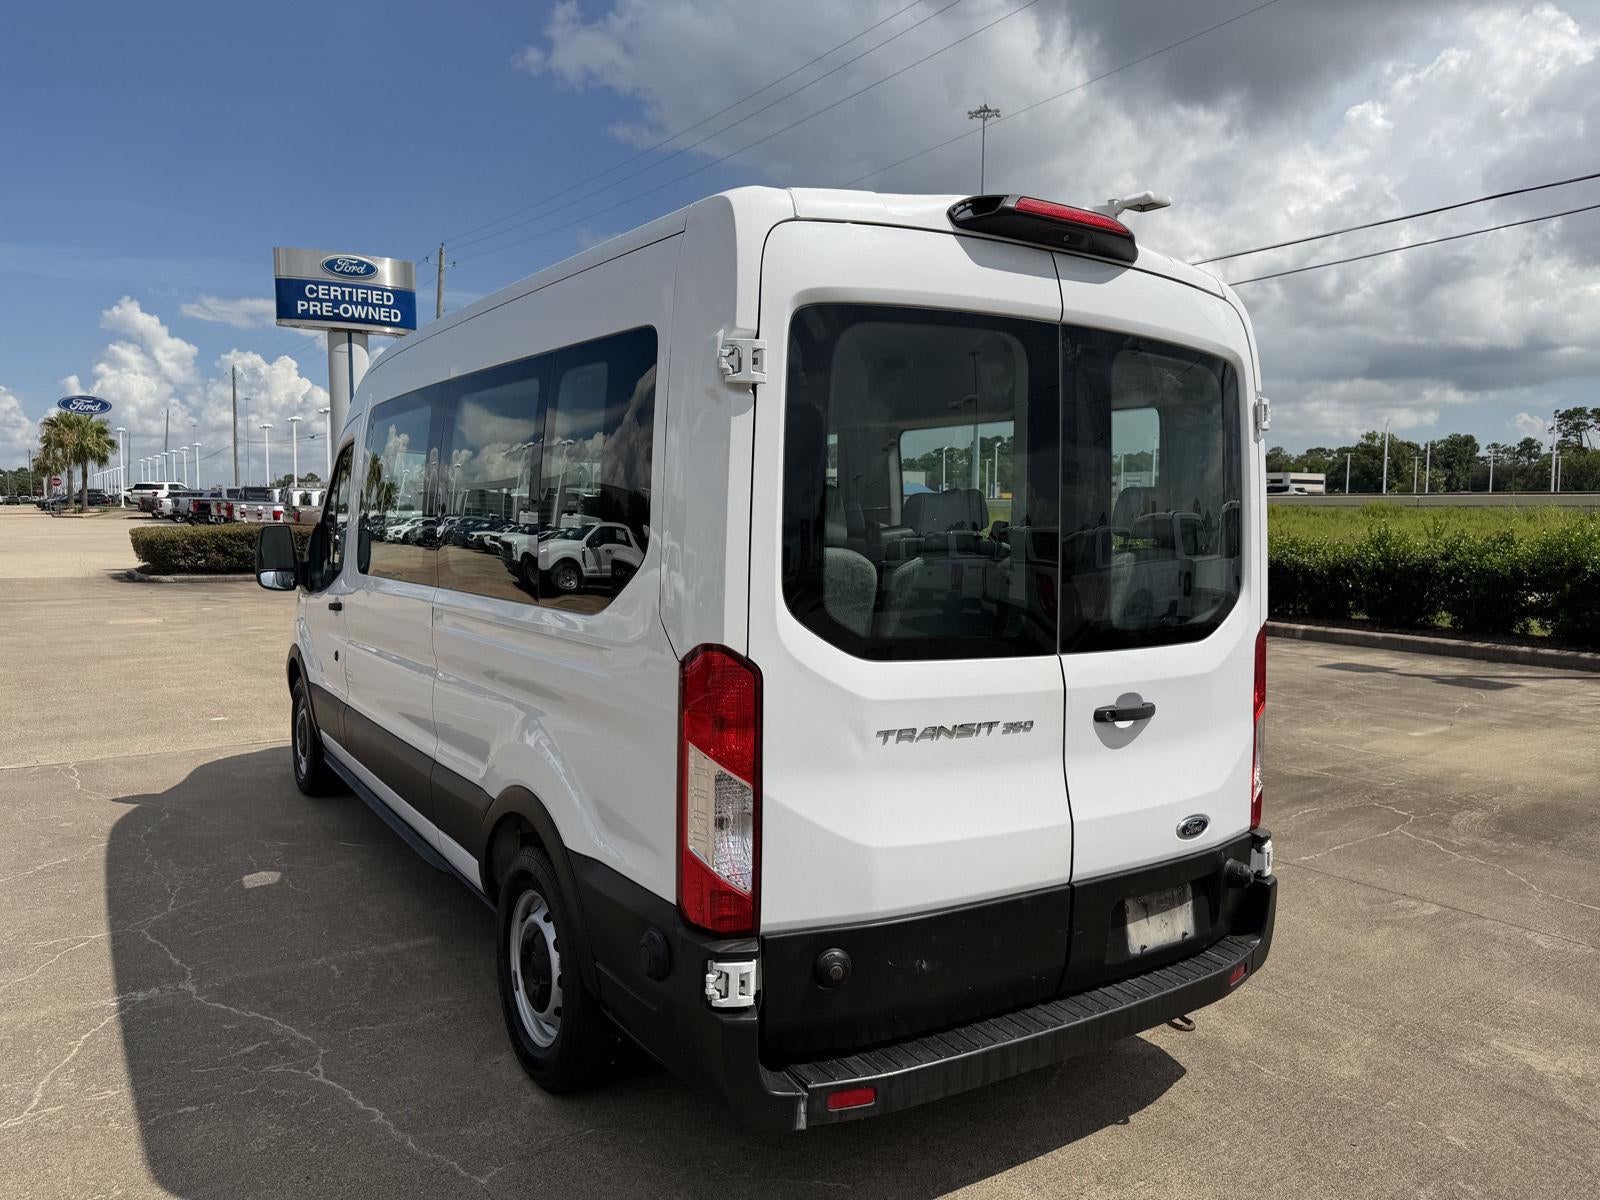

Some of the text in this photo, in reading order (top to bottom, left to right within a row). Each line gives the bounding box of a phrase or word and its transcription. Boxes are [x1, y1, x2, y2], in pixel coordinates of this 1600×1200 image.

[334, 257, 367, 275] Ford
[304, 284, 394, 305] CERTIFIED
[297, 301, 401, 322] PRE-OWNED
[70, 398, 101, 411] Ford
[876, 720, 1034, 745] TRANSIT 350
